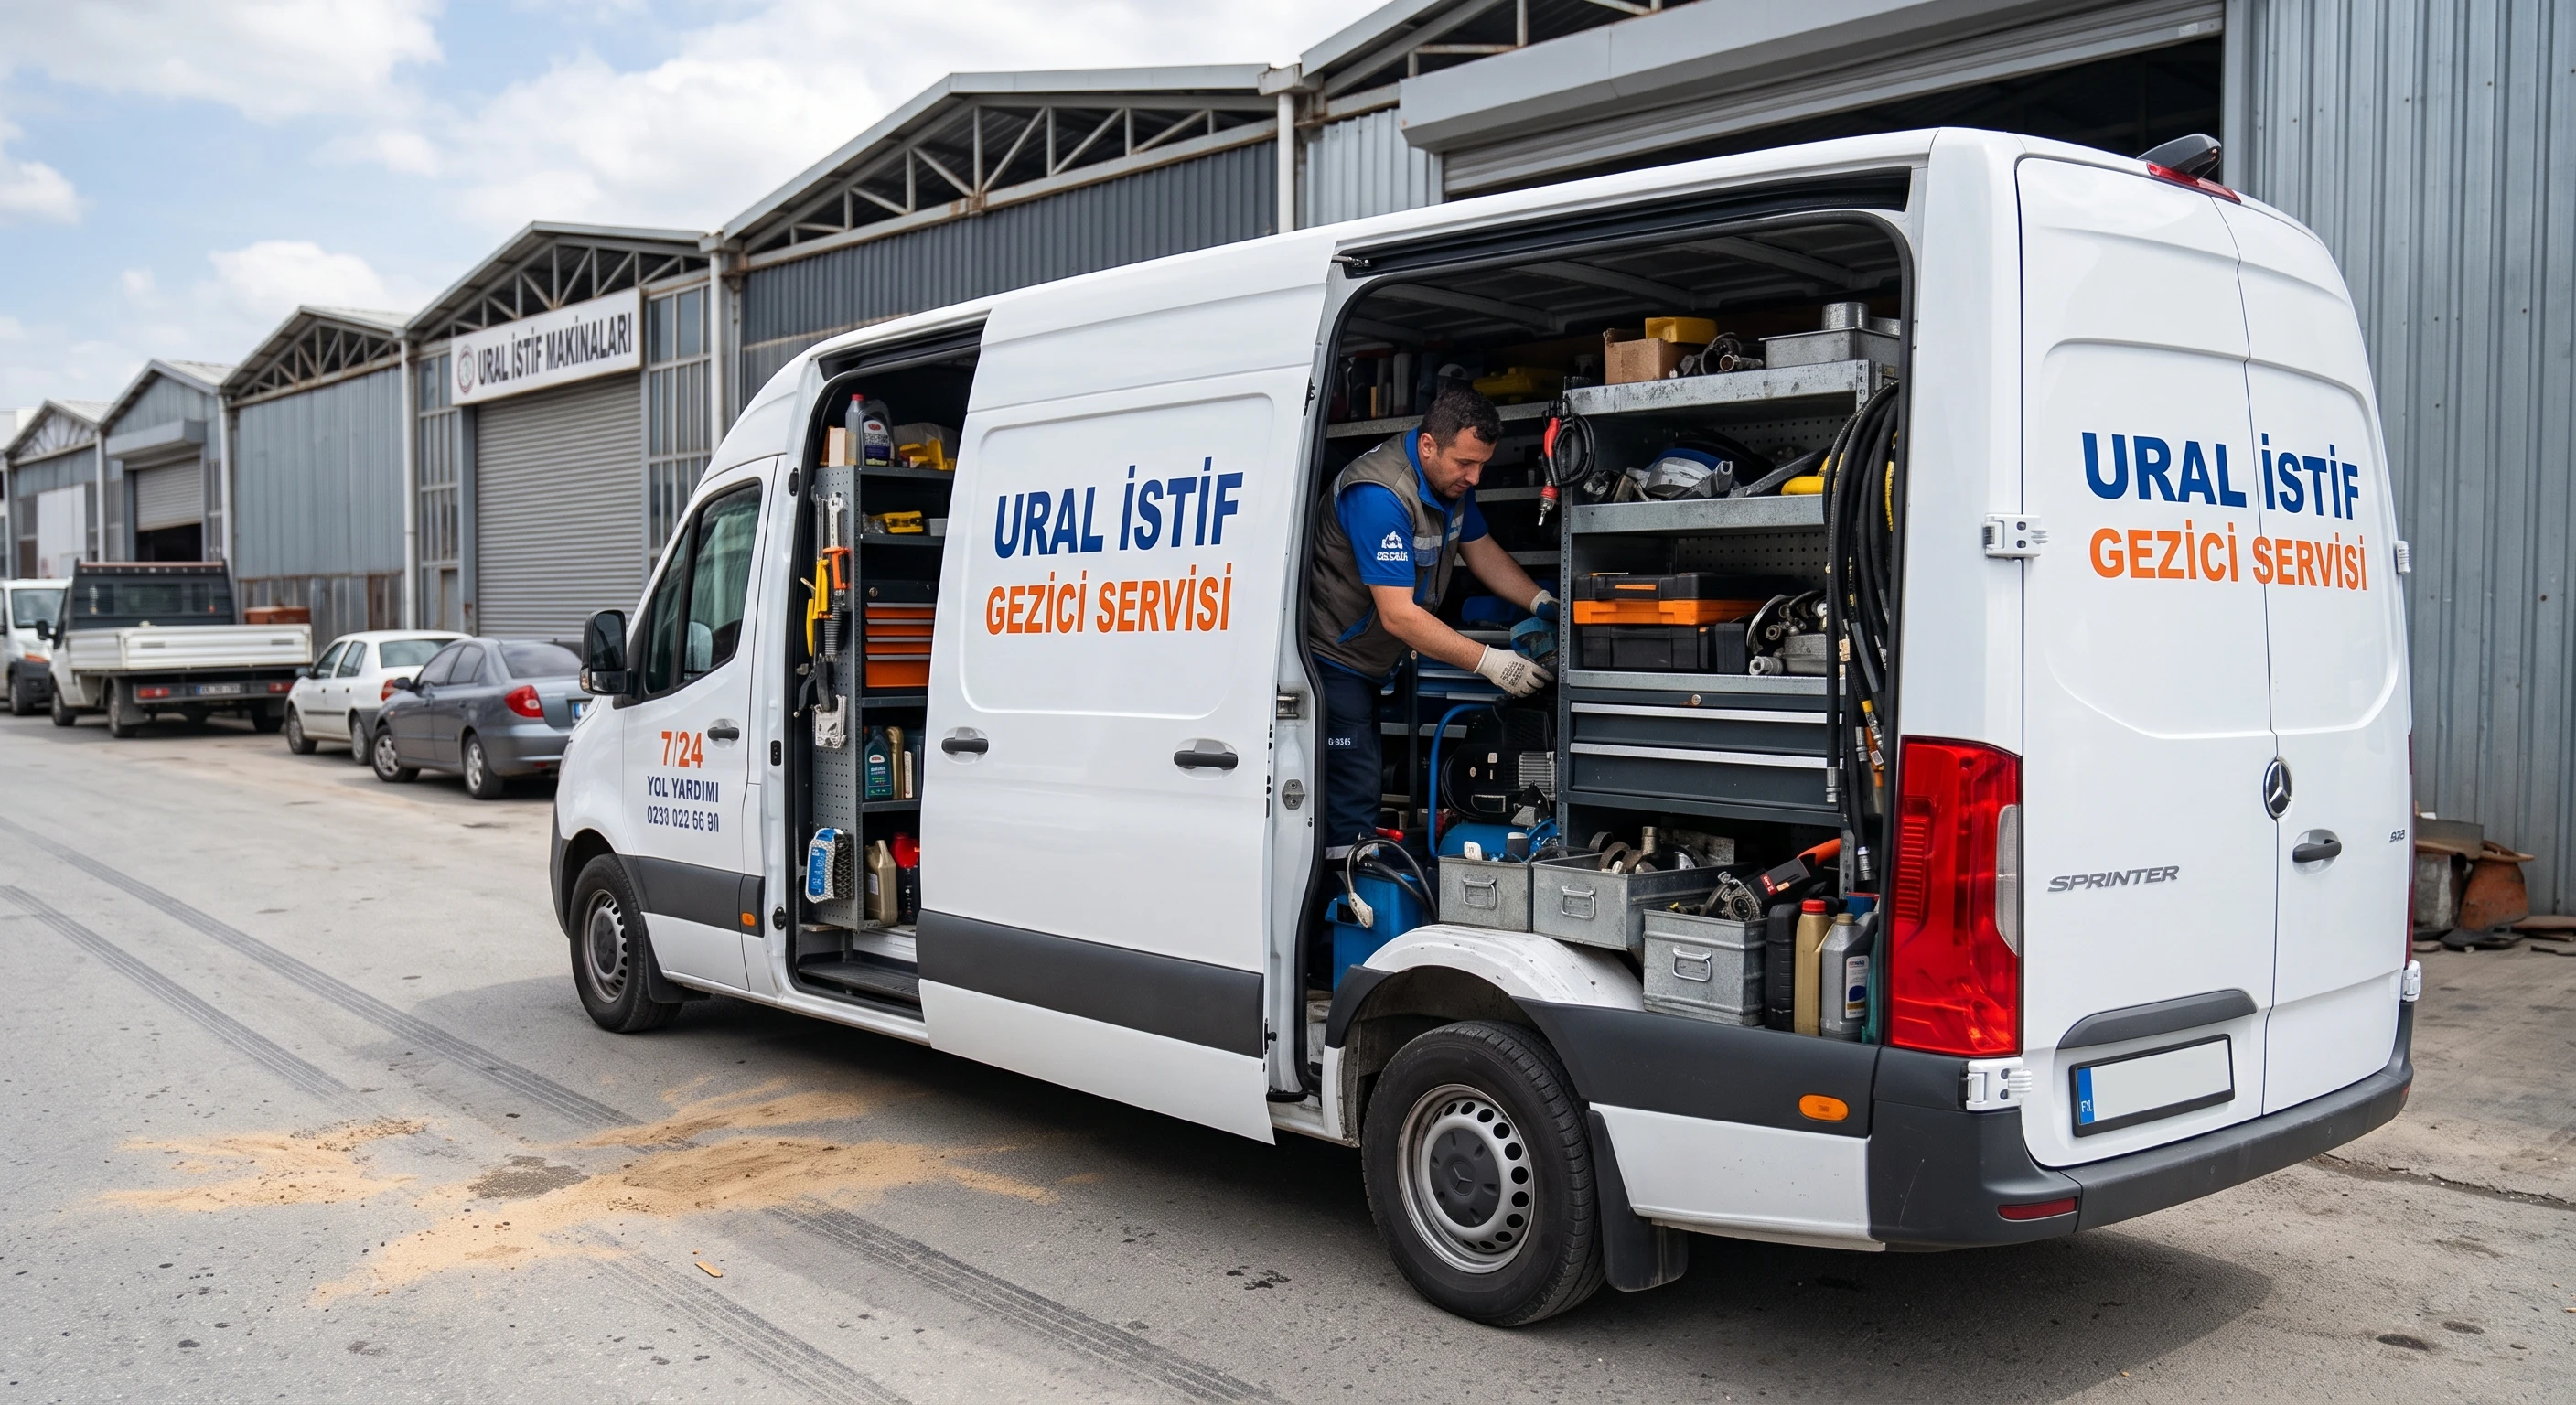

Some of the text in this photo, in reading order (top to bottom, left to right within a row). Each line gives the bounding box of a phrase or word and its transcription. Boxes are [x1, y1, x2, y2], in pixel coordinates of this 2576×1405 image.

[478, 312, 633, 385] URAL İSTİF MAKİNALARI
[993, 456, 1244, 559] URAL İSTİF
[2081, 431, 2360, 520] URAL İSTİF
[2089, 519, 2367, 591] GEZİCİ SERVİSİ
[985, 563, 1232, 636] GEZİCİ SERVİSİ
[660, 730, 703, 769] 7/24
[647, 775, 719, 803] YOL YARDIMI
[672, 808, 690, 829] 022
[692, 810, 704, 831] 66
[2046, 865, 2180, 893] SPRINTER
